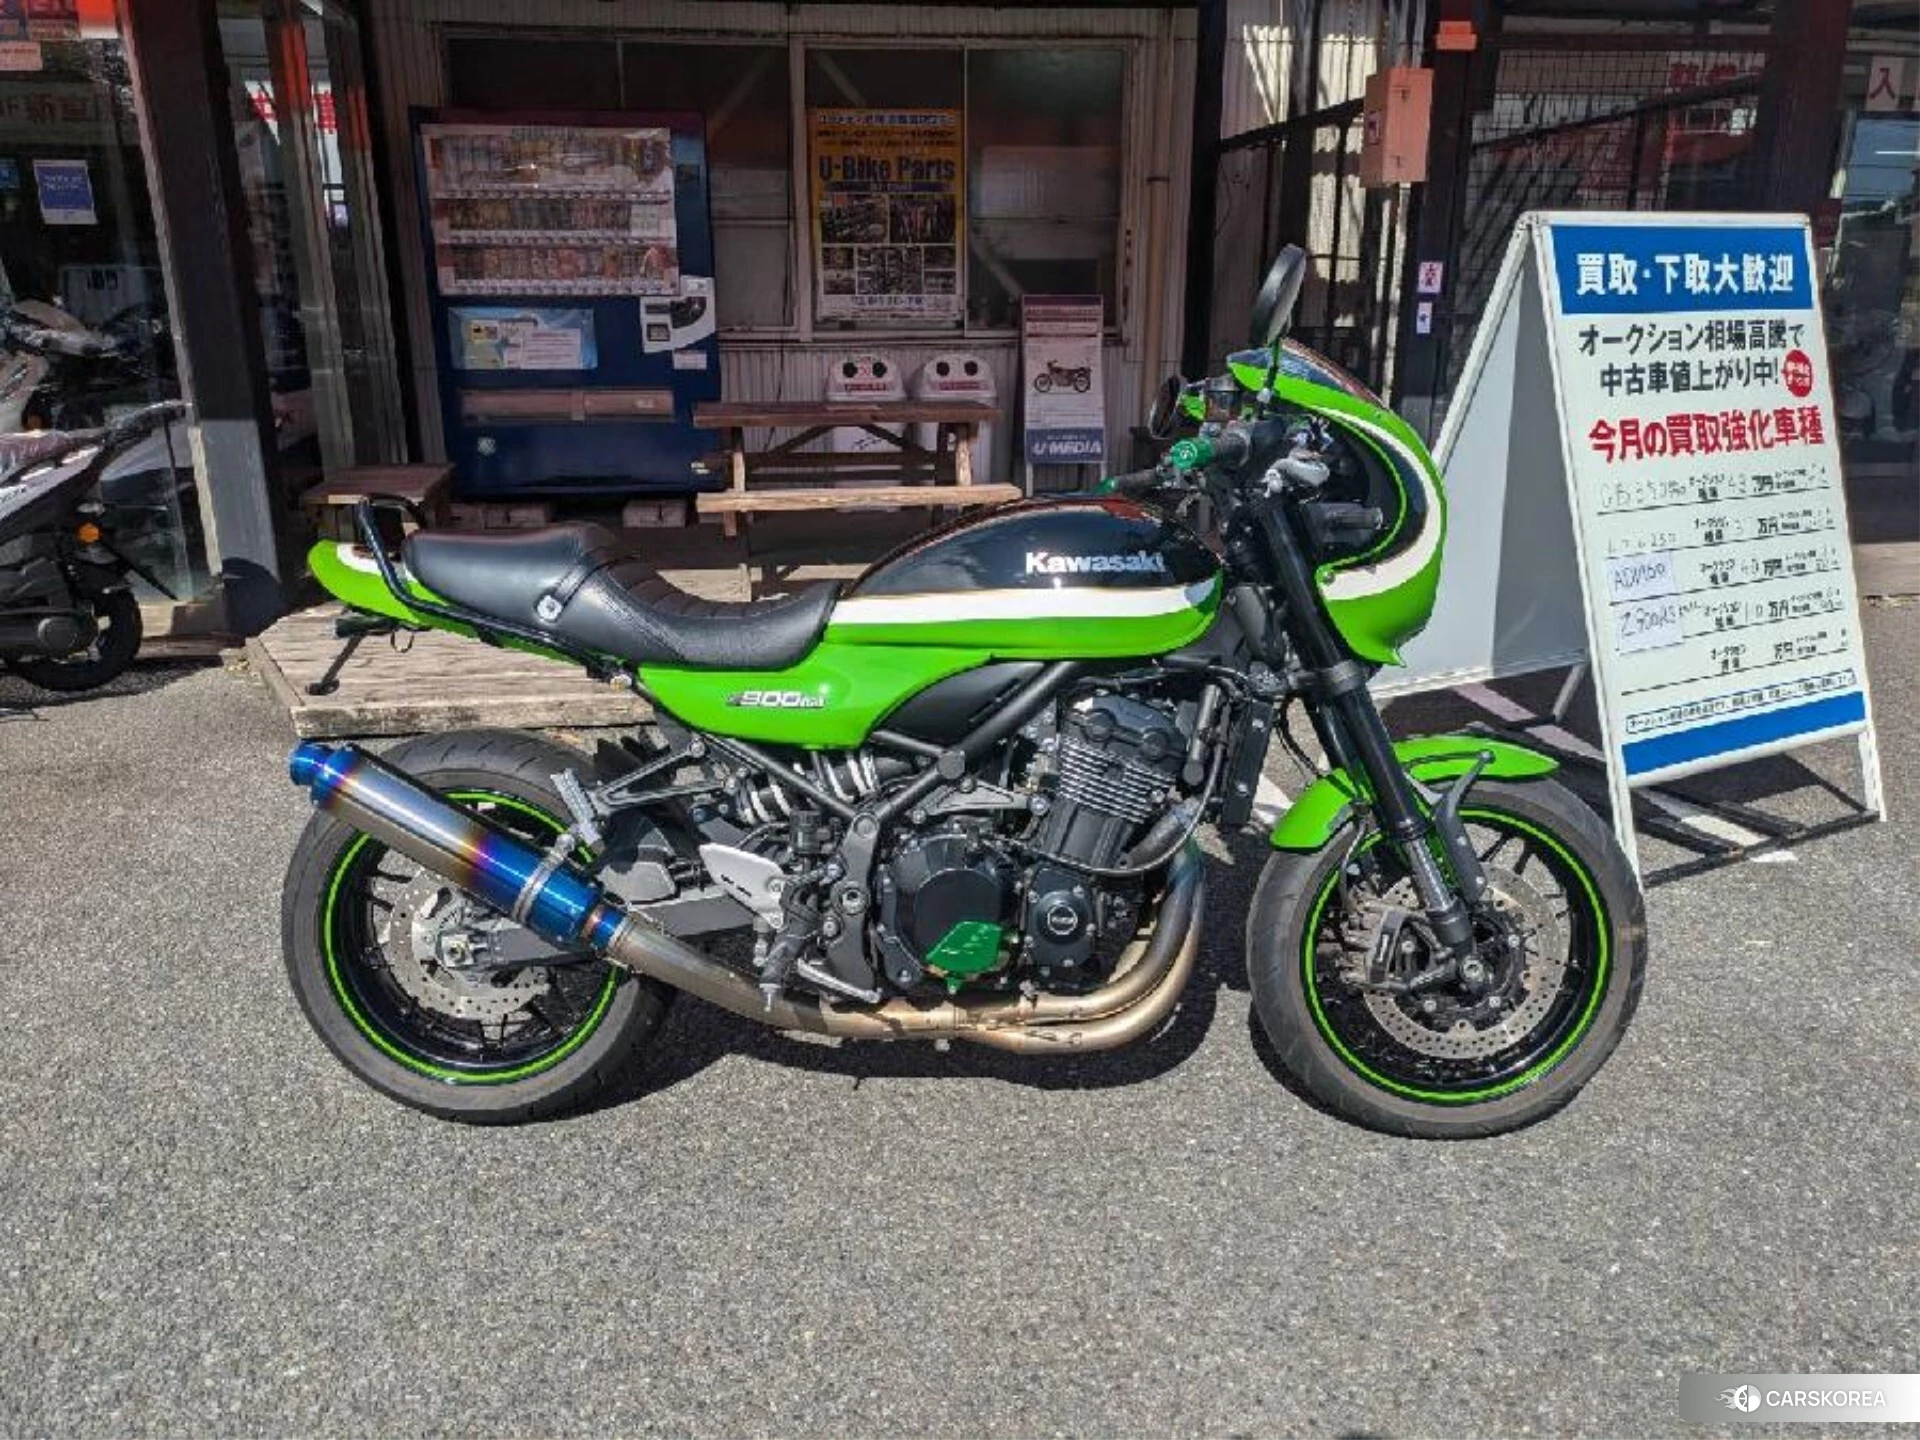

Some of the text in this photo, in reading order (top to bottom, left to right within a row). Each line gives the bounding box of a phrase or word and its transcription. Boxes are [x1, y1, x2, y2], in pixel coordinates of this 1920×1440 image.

[818, 154, 956, 181] U-Bike Parts
[1576, 253, 1794, 296] 買取・下取大歓迎
[1578, 320, 1805, 356] オークション相場高騰で
[1588, 405, 1825, 463] 今月の買取強化車種
[1025, 550, 1167, 575] Kawasaki
